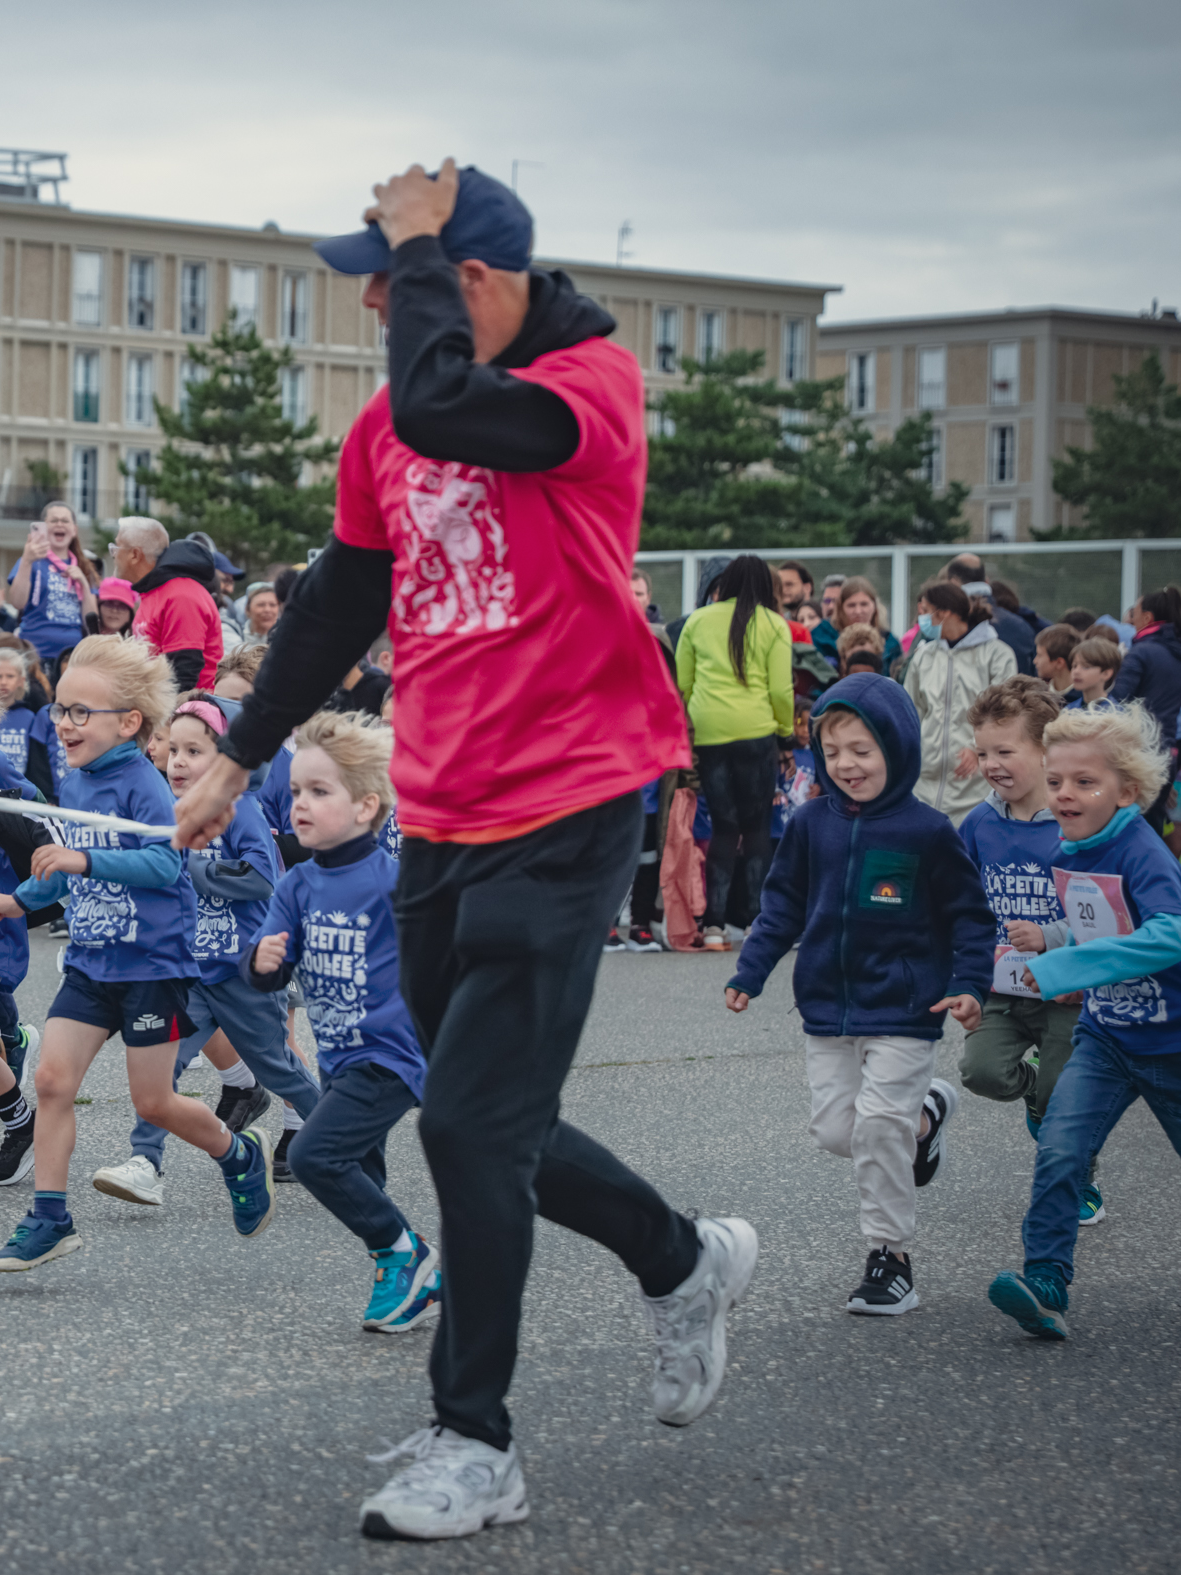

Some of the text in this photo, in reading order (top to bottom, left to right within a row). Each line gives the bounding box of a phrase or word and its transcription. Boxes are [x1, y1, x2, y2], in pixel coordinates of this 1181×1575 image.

[986, 874, 1057, 897] LA PETITE
[993, 895, 1050, 916] FOULEE
[1077, 901, 1095, 920] 20
[309, 924, 367, 954] PETITE
